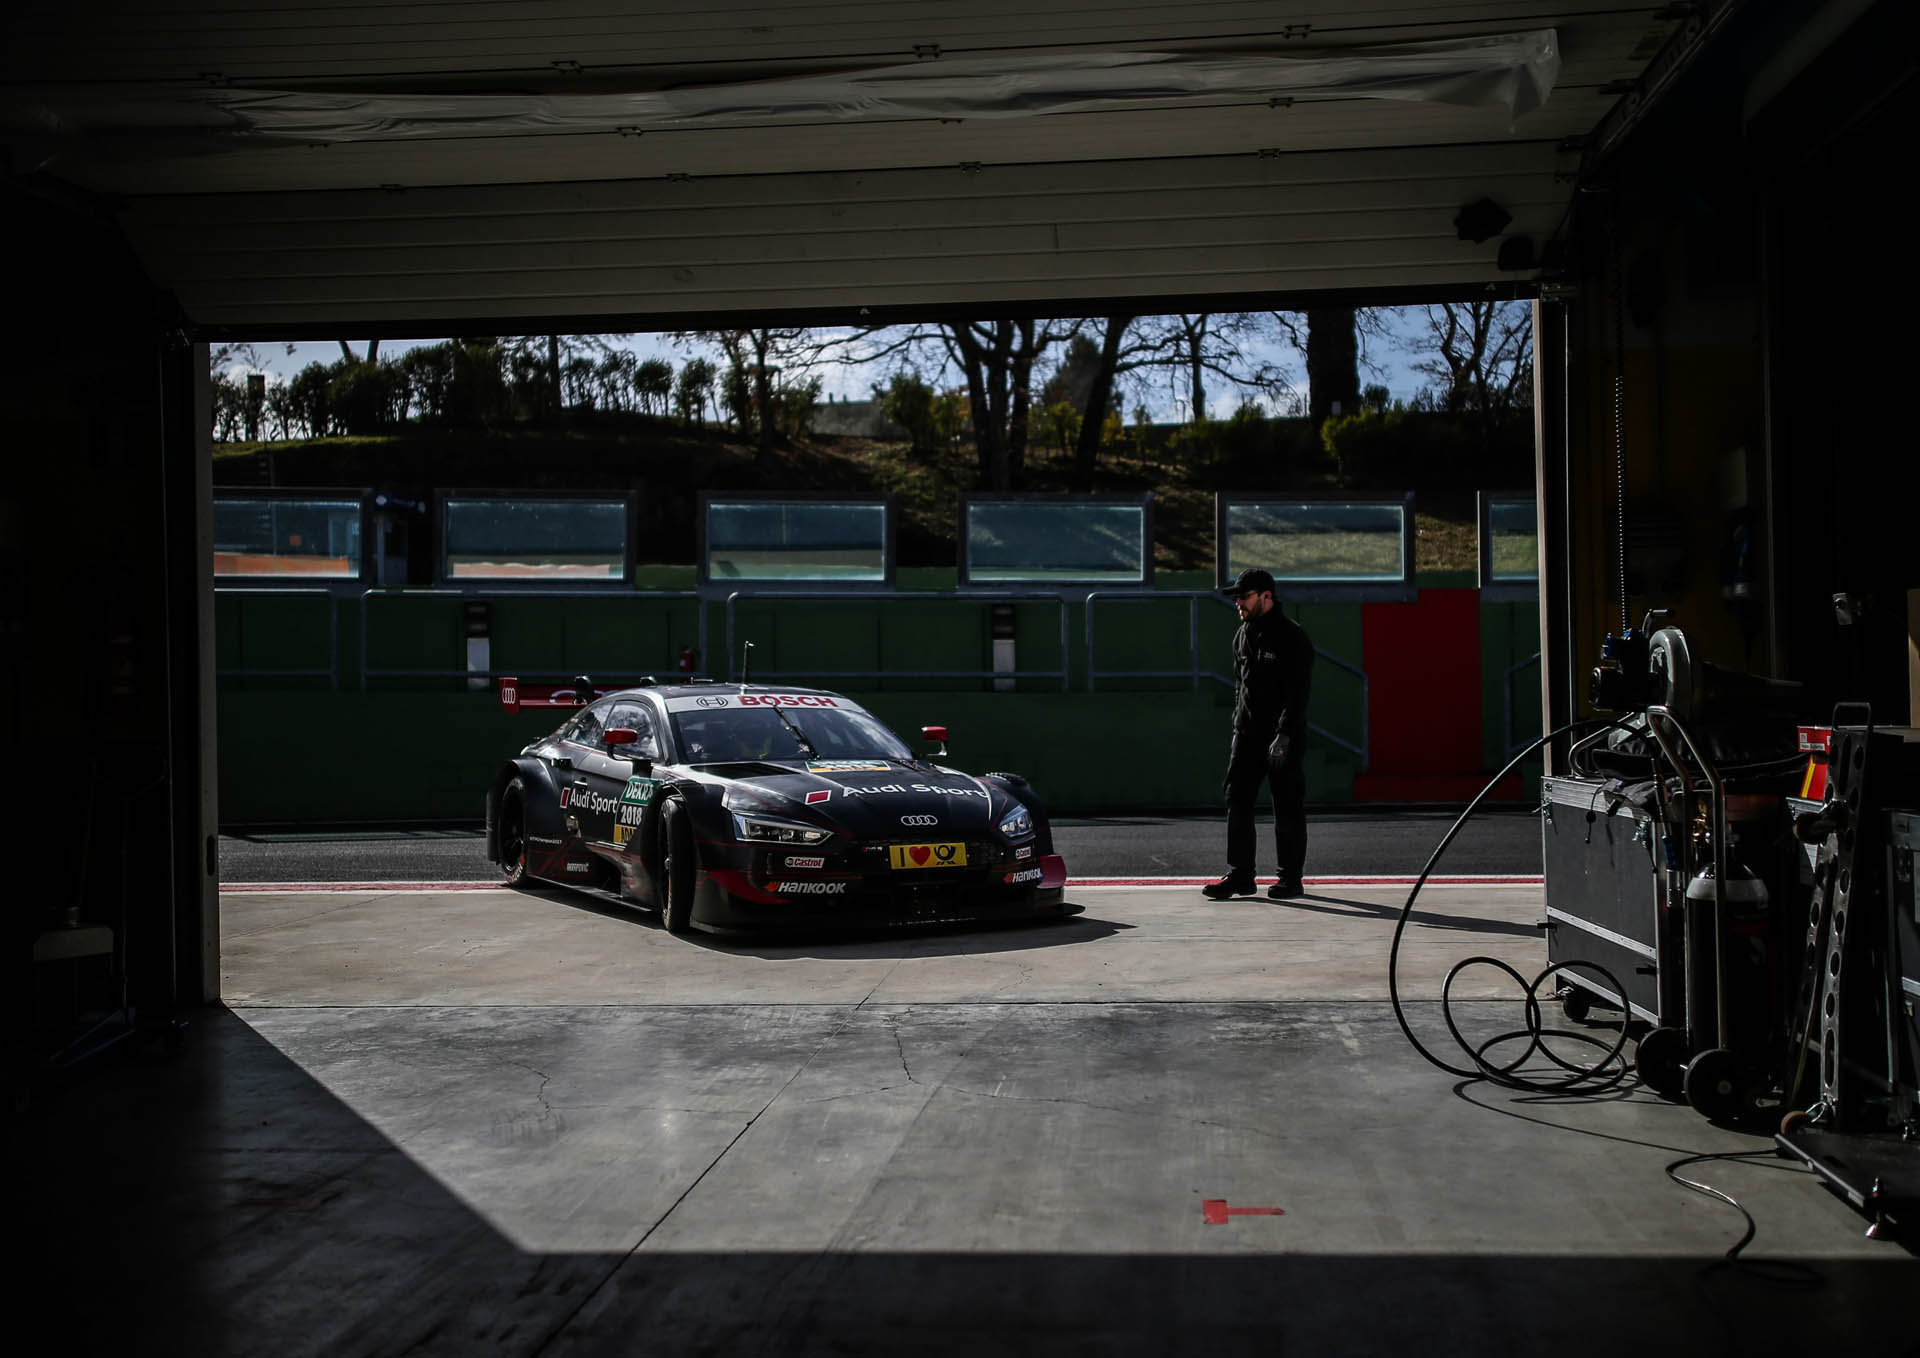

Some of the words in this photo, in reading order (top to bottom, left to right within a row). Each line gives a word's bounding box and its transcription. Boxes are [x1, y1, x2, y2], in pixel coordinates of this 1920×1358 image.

[739, 696, 838, 707] BOSCH
[843, 784, 905, 797] Audi
[911, 783, 990, 798] Sport
[569, 788, 590, 808] Audi
[590, 791, 618, 815] Sport
[620, 805, 642, 825] 2018
[794, 858, 821, 867] Castrol
